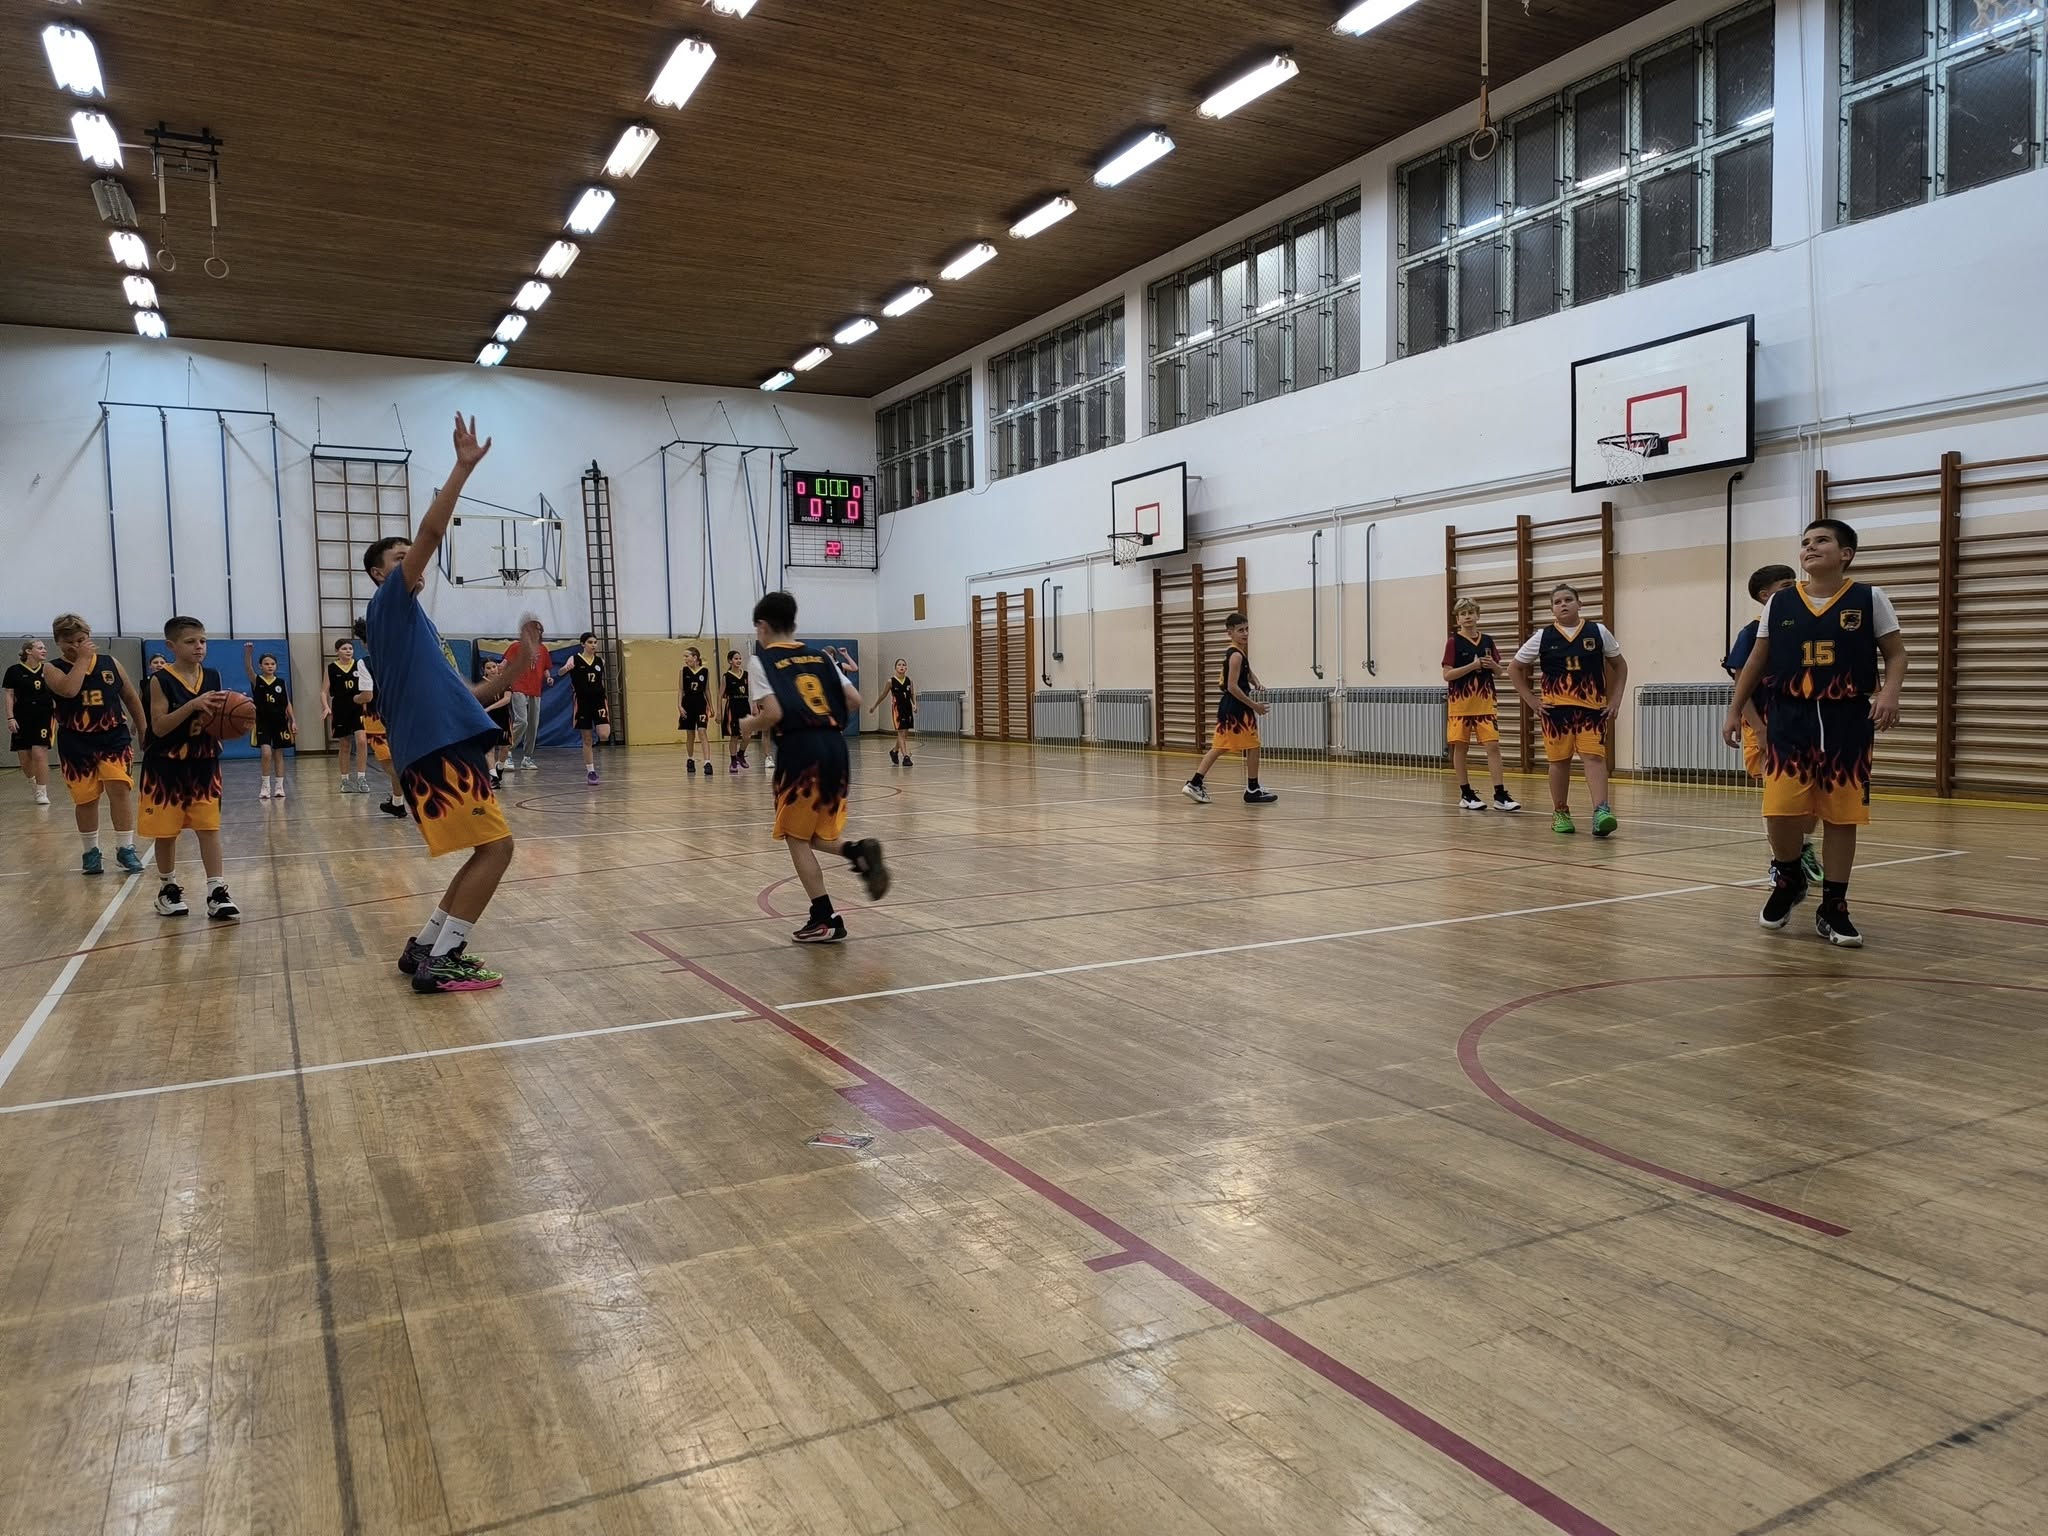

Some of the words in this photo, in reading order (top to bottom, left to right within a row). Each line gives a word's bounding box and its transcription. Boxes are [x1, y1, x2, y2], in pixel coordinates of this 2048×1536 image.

[810, 498, 822, 517] 0
[847, 500, 859, 519] 0
[1801, 639, 1836, 667] 15
[1565, 655, 1582, 671] 11
[34, 680, 41, 690] 8
[344, 679, 354, 689] 10
[81, 689, 105, 707] 12
[266, 693, 276, 703] 16
[40, 728, 48, 738] 8
[279, 730, 290, 741] 16
